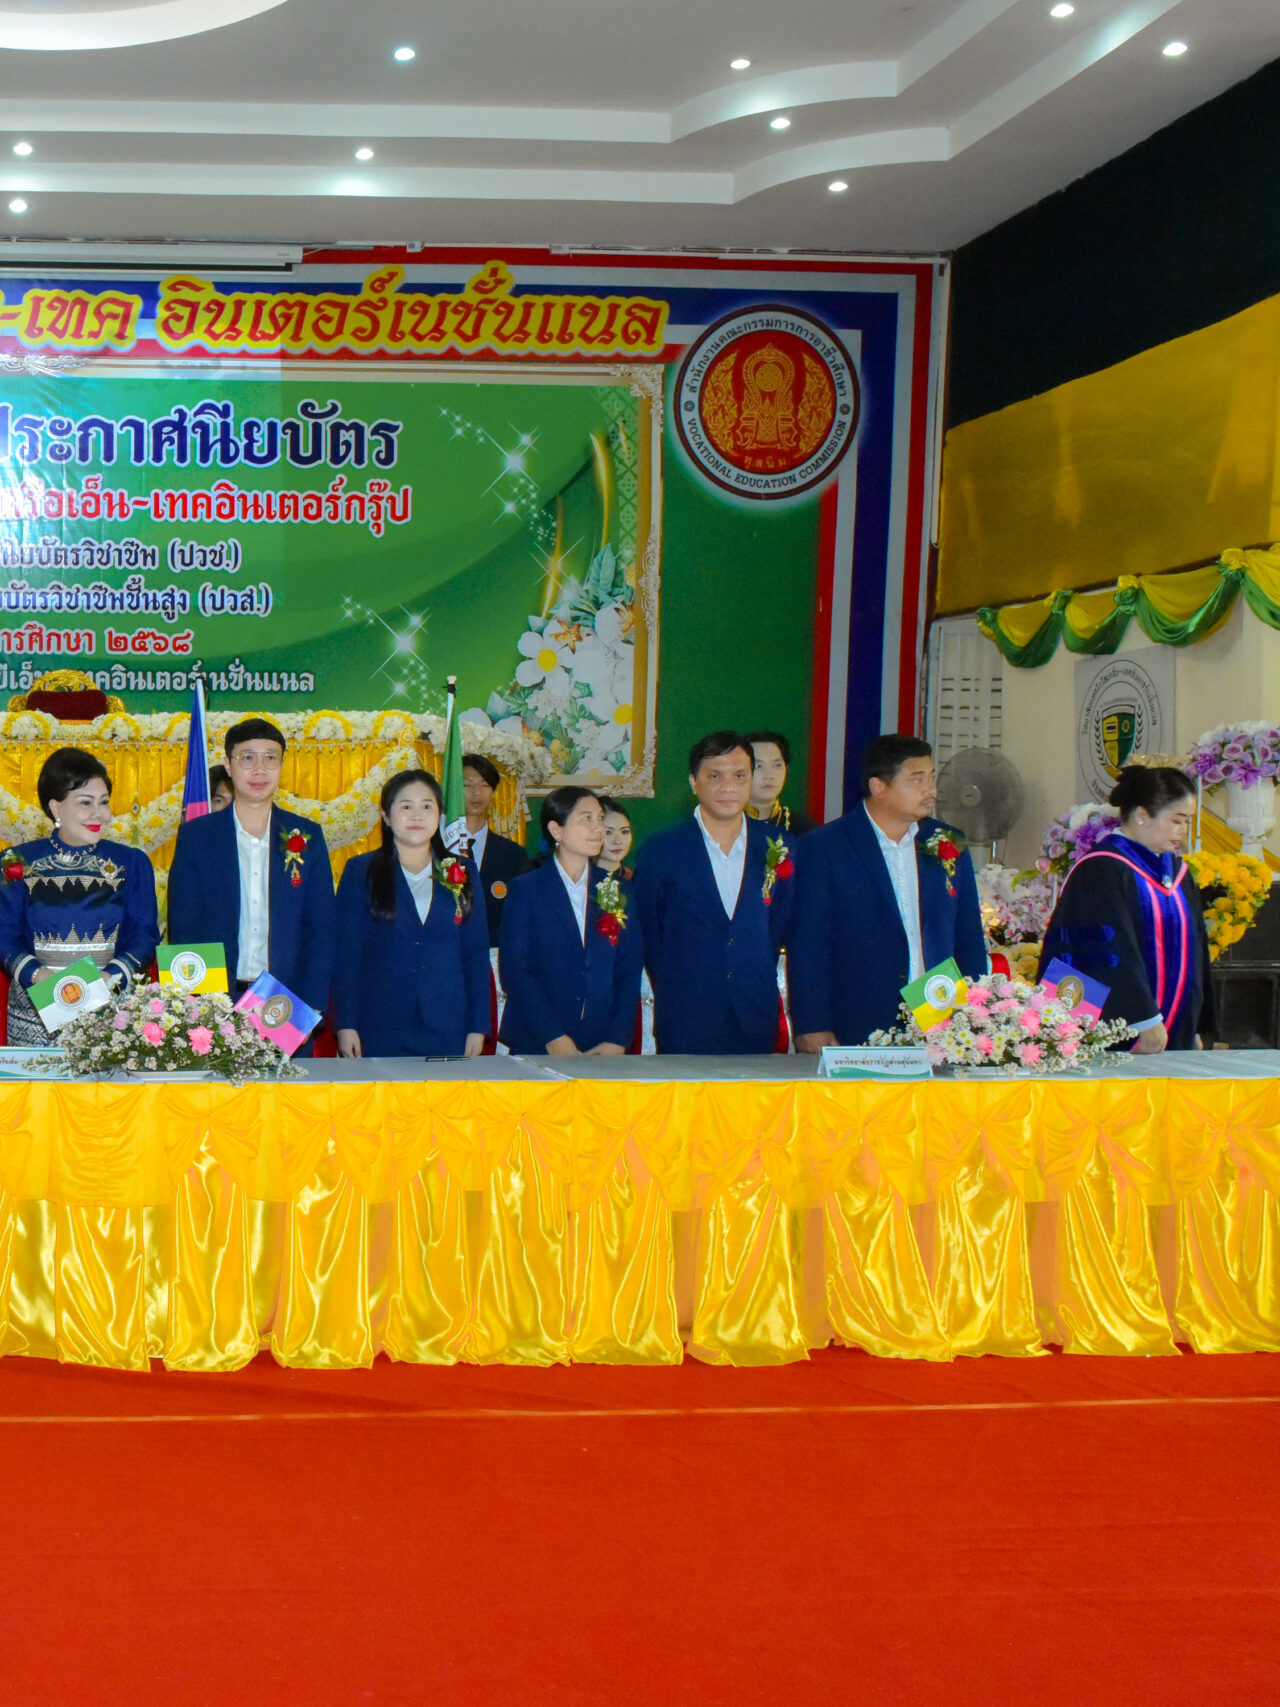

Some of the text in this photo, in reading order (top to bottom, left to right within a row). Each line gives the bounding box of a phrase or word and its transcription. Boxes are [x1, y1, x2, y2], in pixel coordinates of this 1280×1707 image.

[161, 266, 664, 345] อินเตอร์เนชั่นแนล
[687, 418, 847, 489] VOCATIONAL EDUCATION COMMISSION
[170, 540, 240, 570] (ปวช.)
[202, 586, 271, 615] (ปวส.)
[107, 631, 193, 652] ๒๕๖๘
